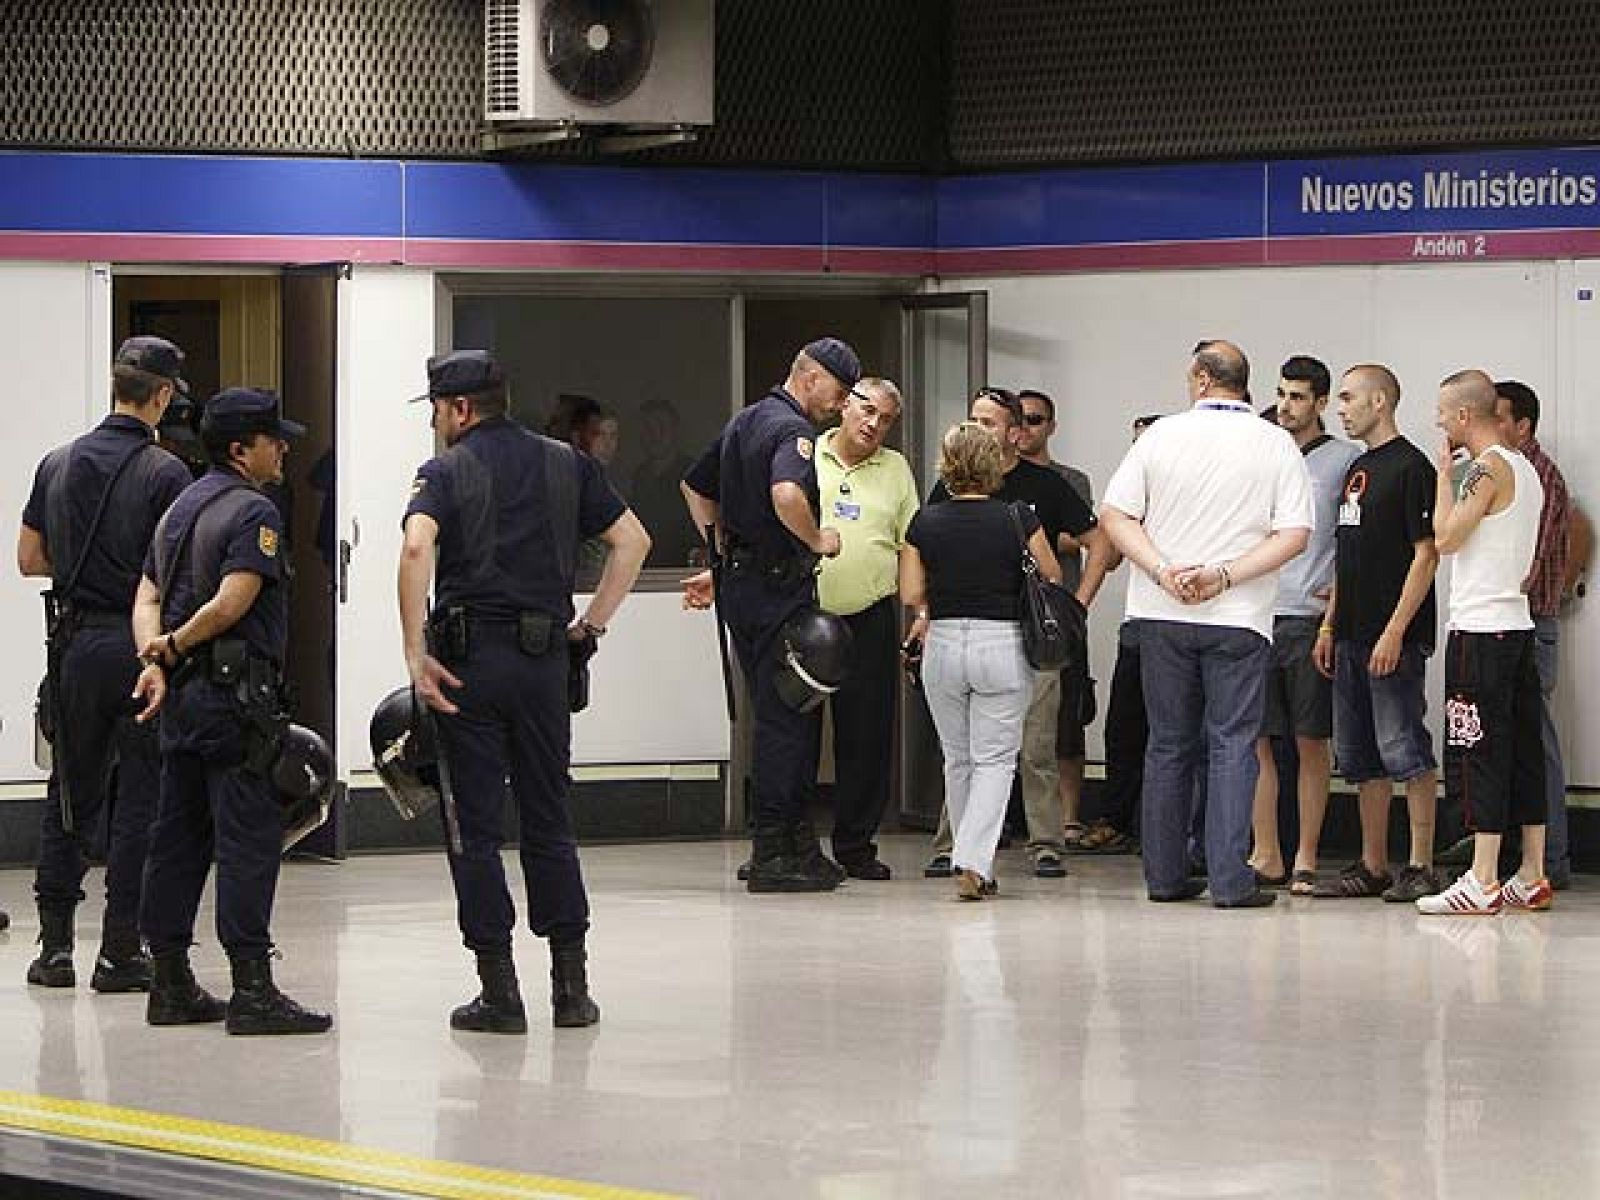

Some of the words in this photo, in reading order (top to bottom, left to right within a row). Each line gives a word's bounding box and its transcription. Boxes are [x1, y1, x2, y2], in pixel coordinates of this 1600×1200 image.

[1301, 176, 1414, 214] Nuevos
[1424, 168, 1597, 209] Ministerios
[1412, 235, 1467, 256] Andén
[1474, 235, 1486, 256] 2
